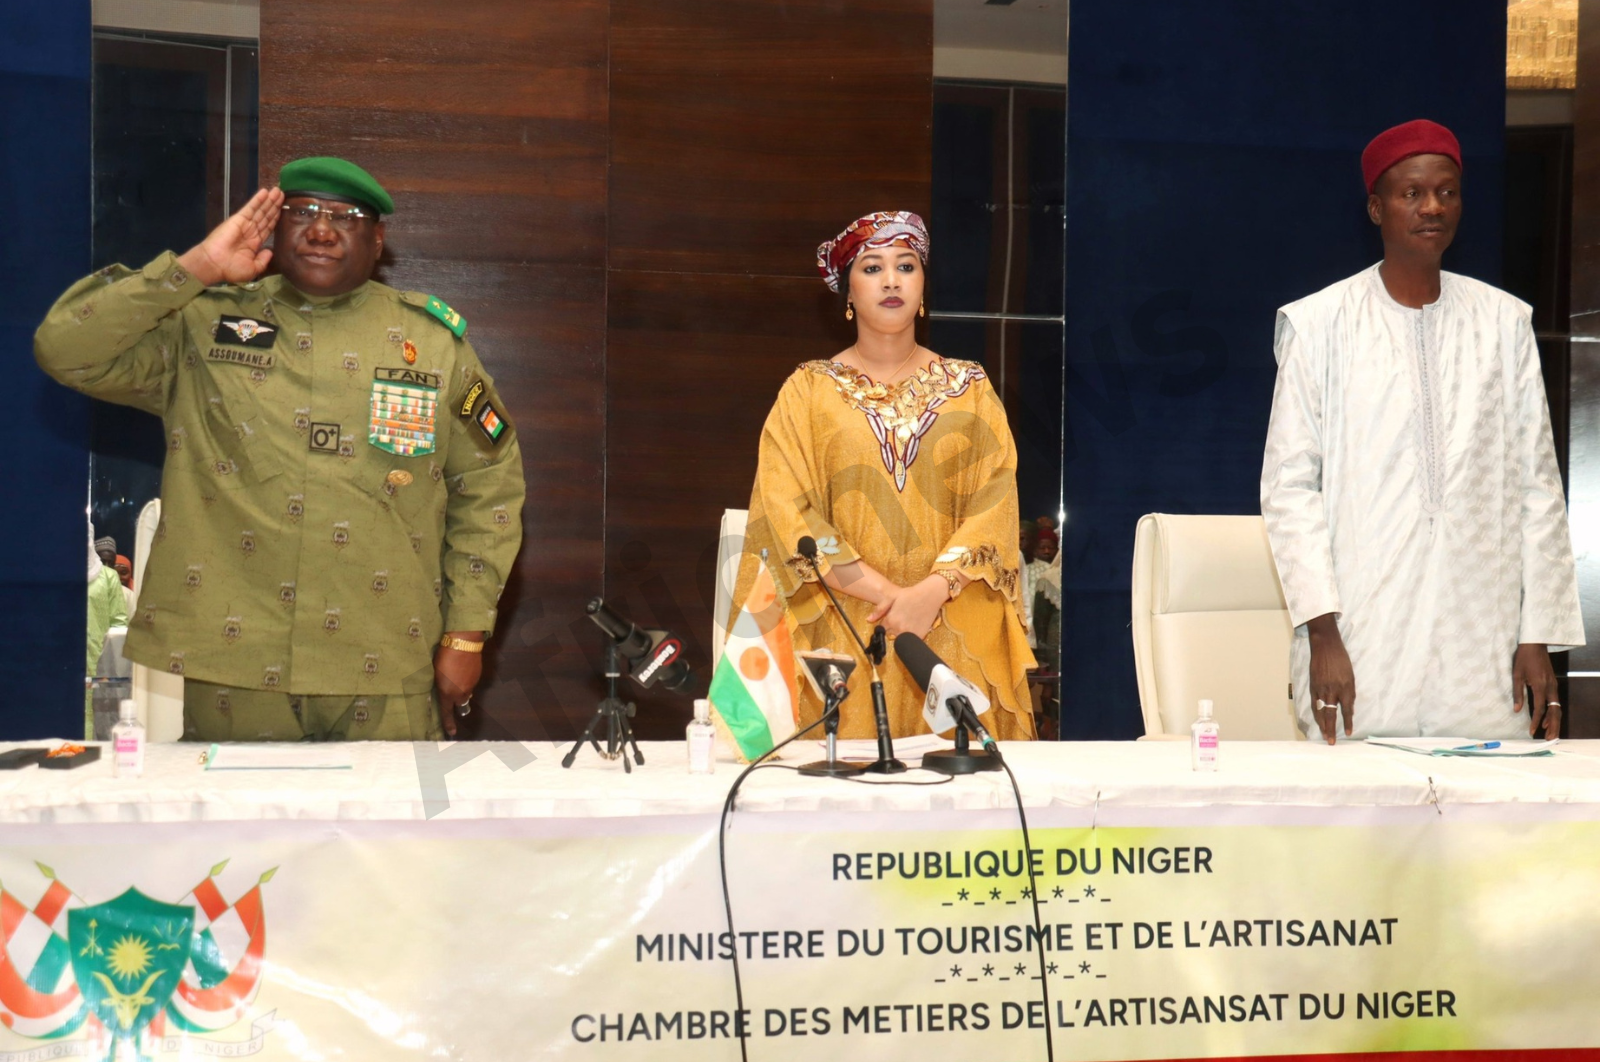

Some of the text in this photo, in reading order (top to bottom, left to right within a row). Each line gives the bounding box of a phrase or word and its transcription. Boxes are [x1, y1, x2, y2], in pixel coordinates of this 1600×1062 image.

[208, 348, 273, 366] ASSOUMANE.A
[387, 370, 428, 384] FAN
[833, 846, 1214, 881] REPUBLIQUE DU NIGER
[636, 918, 1399, 962] MINISTERE DU TOURISME ET DE L’ARTISANAT
[571, 989, 1457, 1043] CHAMBRE DES METIERS DE L’ARTISANSAT DU NIGER
[204, 1041, 257, 1056] NIGER
